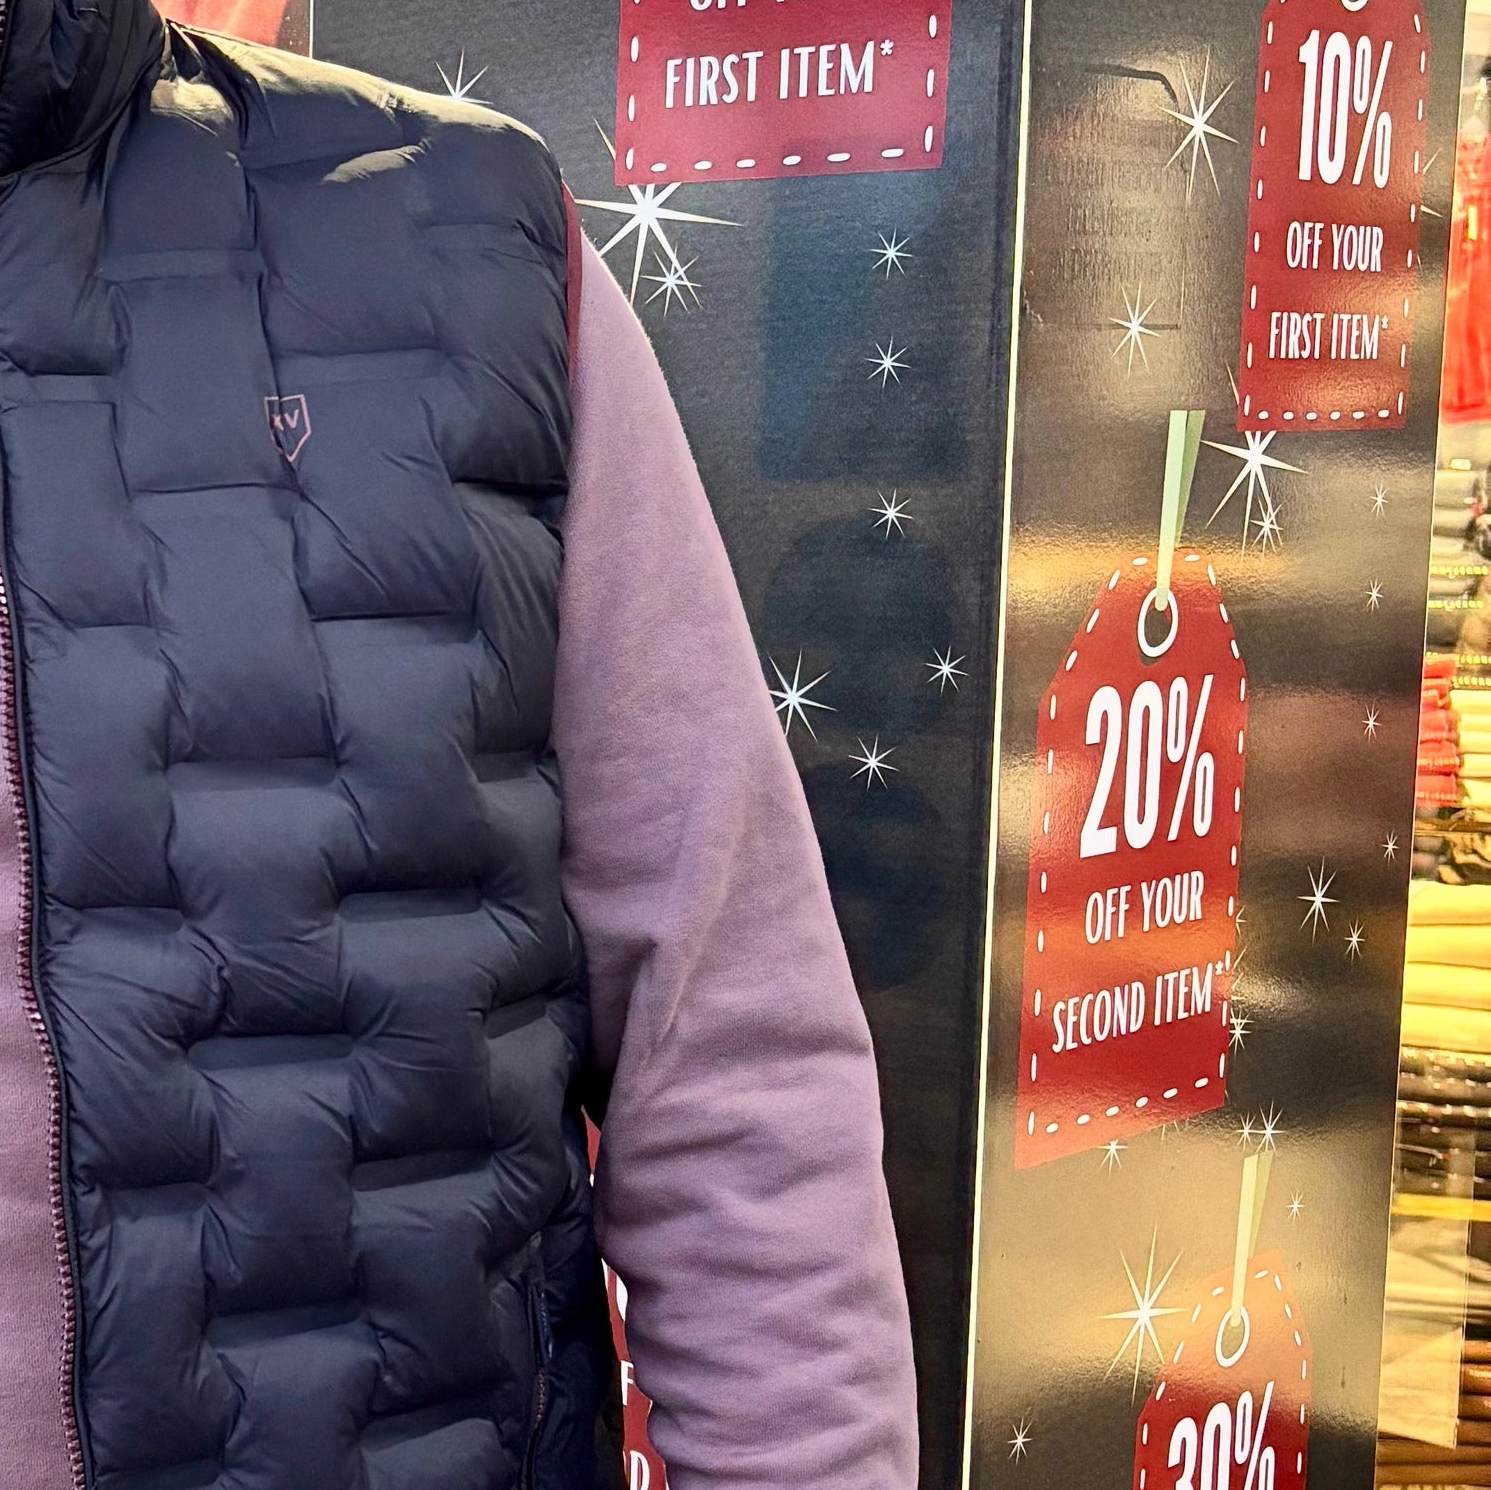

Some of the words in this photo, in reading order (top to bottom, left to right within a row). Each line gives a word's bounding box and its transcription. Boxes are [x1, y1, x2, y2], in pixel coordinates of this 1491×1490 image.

[664, 49, 764, 109] FIRST
[1298, 29, 1393, 189] 10%
[1286, 221, 1323, 272] OFF
[1331, 223, 1384, 273] YOUR
[1269, 311, 1325, 360] FIRST
[1079, 673, 1215, 859] 20%
[1085, 885, 1134, 946] OFF
[1140, 869, 1205, 933] YOUR
[1051, 979, 1144, 1055] SECOND
